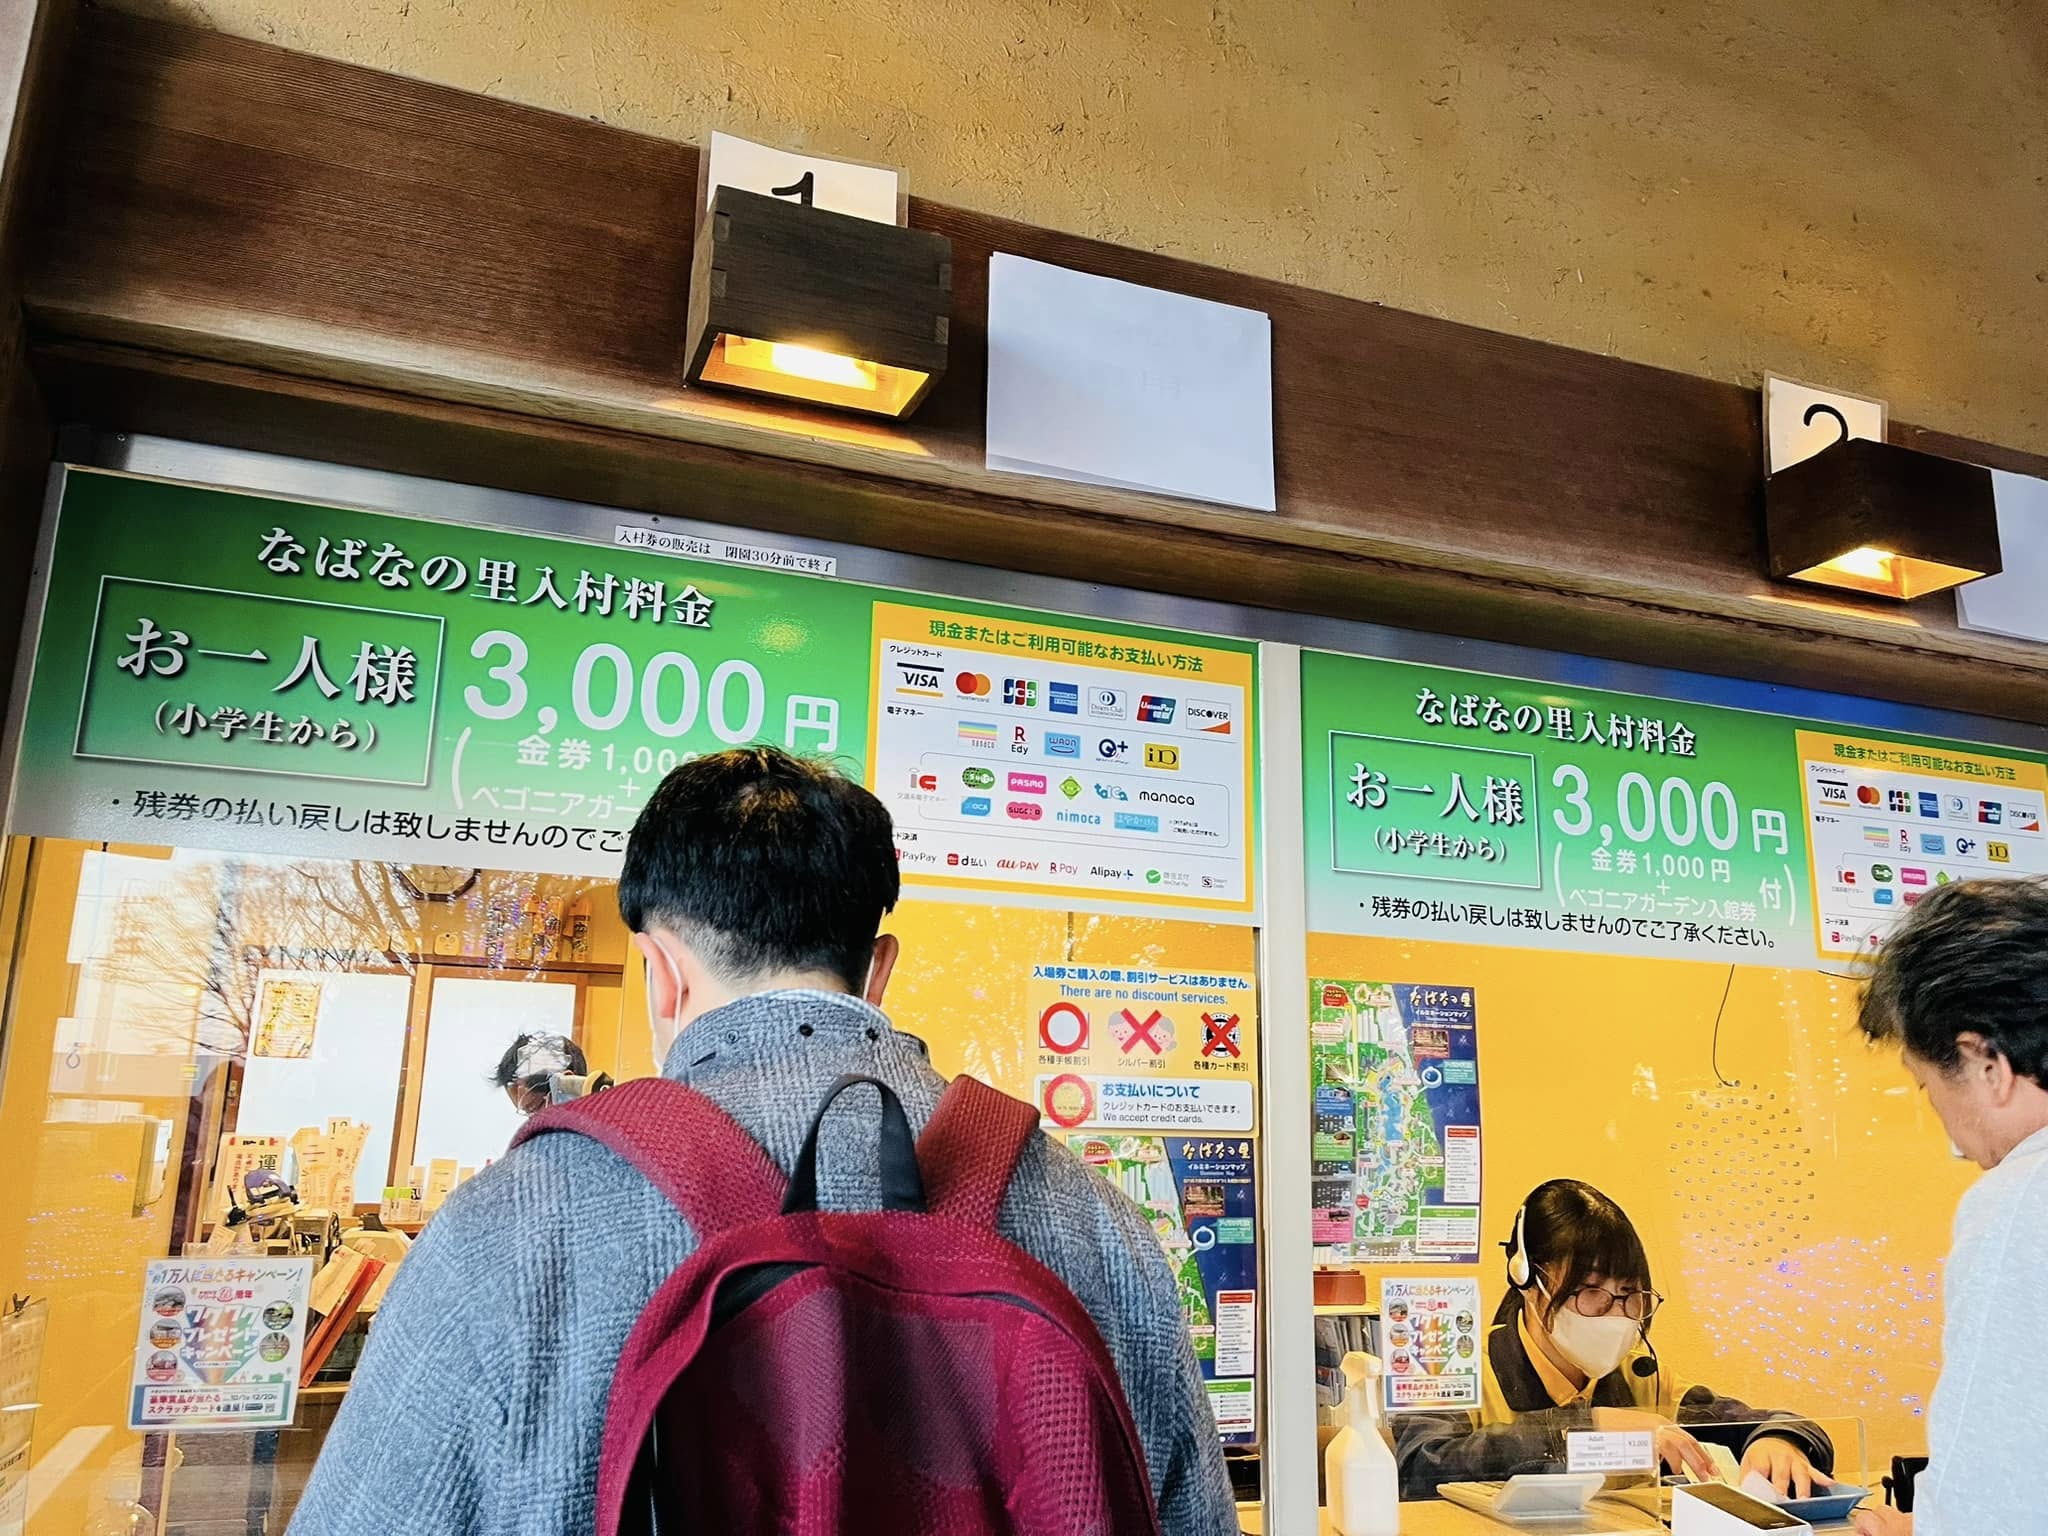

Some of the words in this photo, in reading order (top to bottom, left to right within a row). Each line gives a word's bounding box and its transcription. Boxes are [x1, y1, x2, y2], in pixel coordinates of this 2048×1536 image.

[619, 530, 711, 555] 入村券の販売は
[725, 545, 833, 573] 閉園30分前で終了
[257, 527, 715, 629] なばなの里入村料金
[929, 619, 1204, 673] 現金またはご利用可能なお支払い方法
[116, 617, 418, 706] お一人様
[903, 672, 939, 688] VISA
[1003, 686, 1036, 699] JCB
[1187, 707, 1229, 721] DISCOVER
[1416, 687, 1697, 758] なばなの里入村料金
[1011, 744, 1029, 755] Edy
[1010, 777, 1045, 789] PASMO
[1139, 790, 1195, 806] manaca
[1346, 762, 1525, 825] お一人様
[1822, 786, 1847, 800] VISA
[112, 790, 633, 853] ・残券の払い戻しは致しませんのでご
[1056, 808, 1101, 825] nimoca
[902, 851, 937, 863] PayPay
[1759, 877, 1781, 910] 付
[1569, 888, 1757, 922] ベゴニアガーデン入館券
[1060, 984, 1091, 997] There
[1094, 988, 1112, 998] are
[1116, 989, 1129, 999] no
[1132, 988, 1179, 1002] discount
[1181, 992, 1229, 1005] services.
[1102, 1083, 1201, 1099] お支払いについて
[1103, 1112, 1117, 1121] We
[1119, 1112, 1149, 1123] accept
[1150, 1113, 1176, 1122] credit
